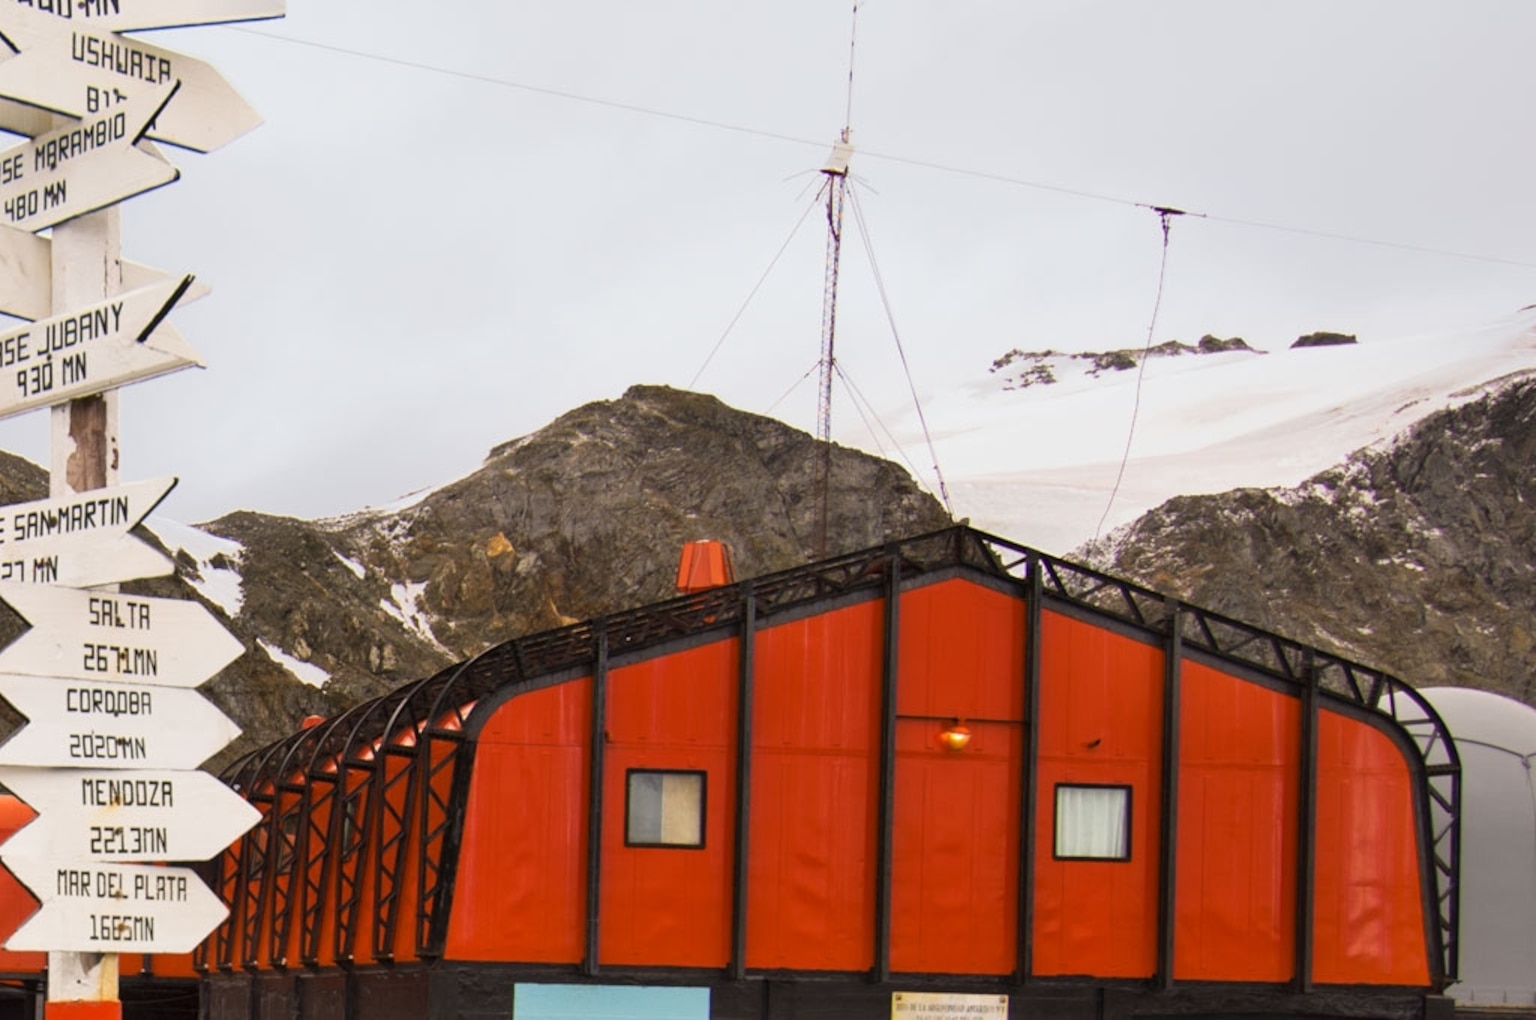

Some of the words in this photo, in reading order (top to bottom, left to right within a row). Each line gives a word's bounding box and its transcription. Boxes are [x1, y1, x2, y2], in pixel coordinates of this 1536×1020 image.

[72, 31, 171, 85] USHUAIA
[34, 112, 126, 172] MARAMBIO
[4, 190, 39, 222] 480
[37, 301, 124, 356] JUBANY
[62, 351, 87, 386] MN
[57, 494, 129, 535] MARTIN
[33, 554, 59, 584] MN
[88, 597, 151, 631] SALTA
[66, 688, 152, 716] CORDOBA
[81, 778, 174, 808] MENDOZA
[56, 868, 91, 898] MAR
[96, 871, 129, 900] DEL
[134, 873, 188, 902] PLATA
